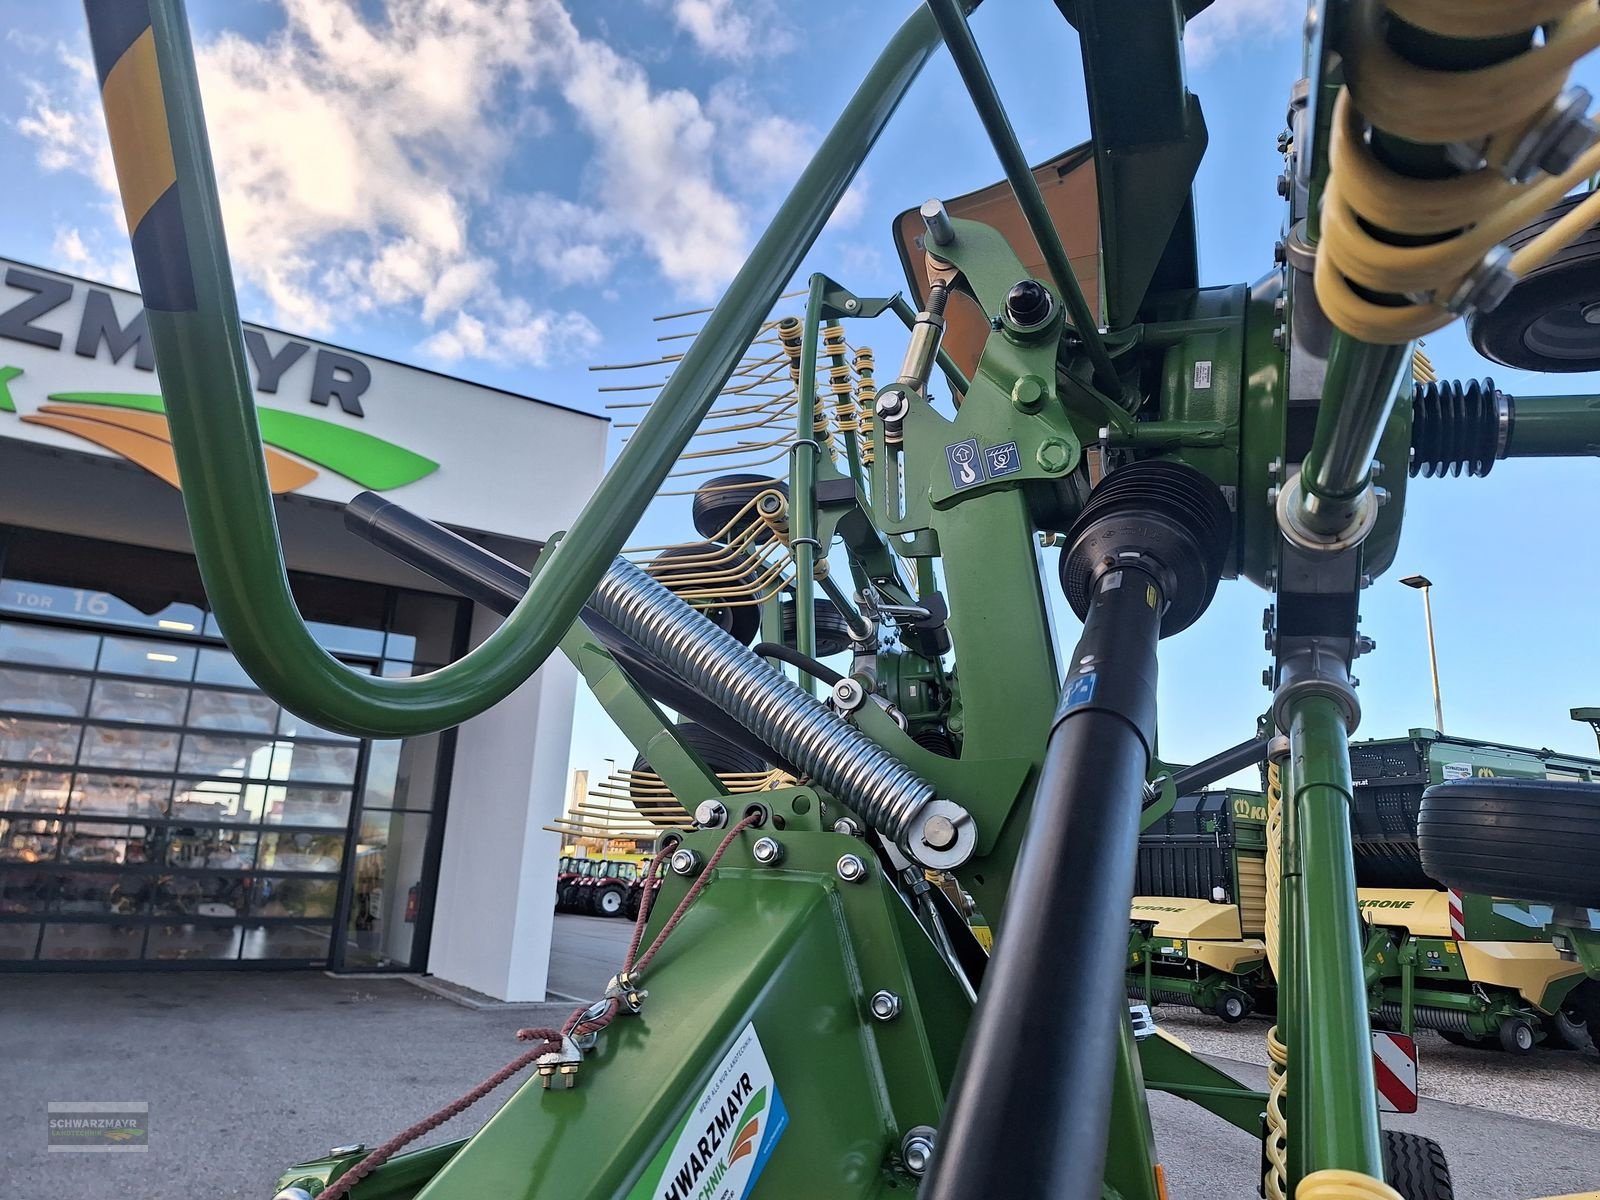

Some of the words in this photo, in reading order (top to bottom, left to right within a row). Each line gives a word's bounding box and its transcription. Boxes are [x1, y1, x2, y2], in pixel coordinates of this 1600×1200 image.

[16, 591, 54, 608] TOR
[73, 590, 110, 615] 16
[1359, 899, 1416, 909] KRONE
[711, 1082, 720, 1096] ALS
